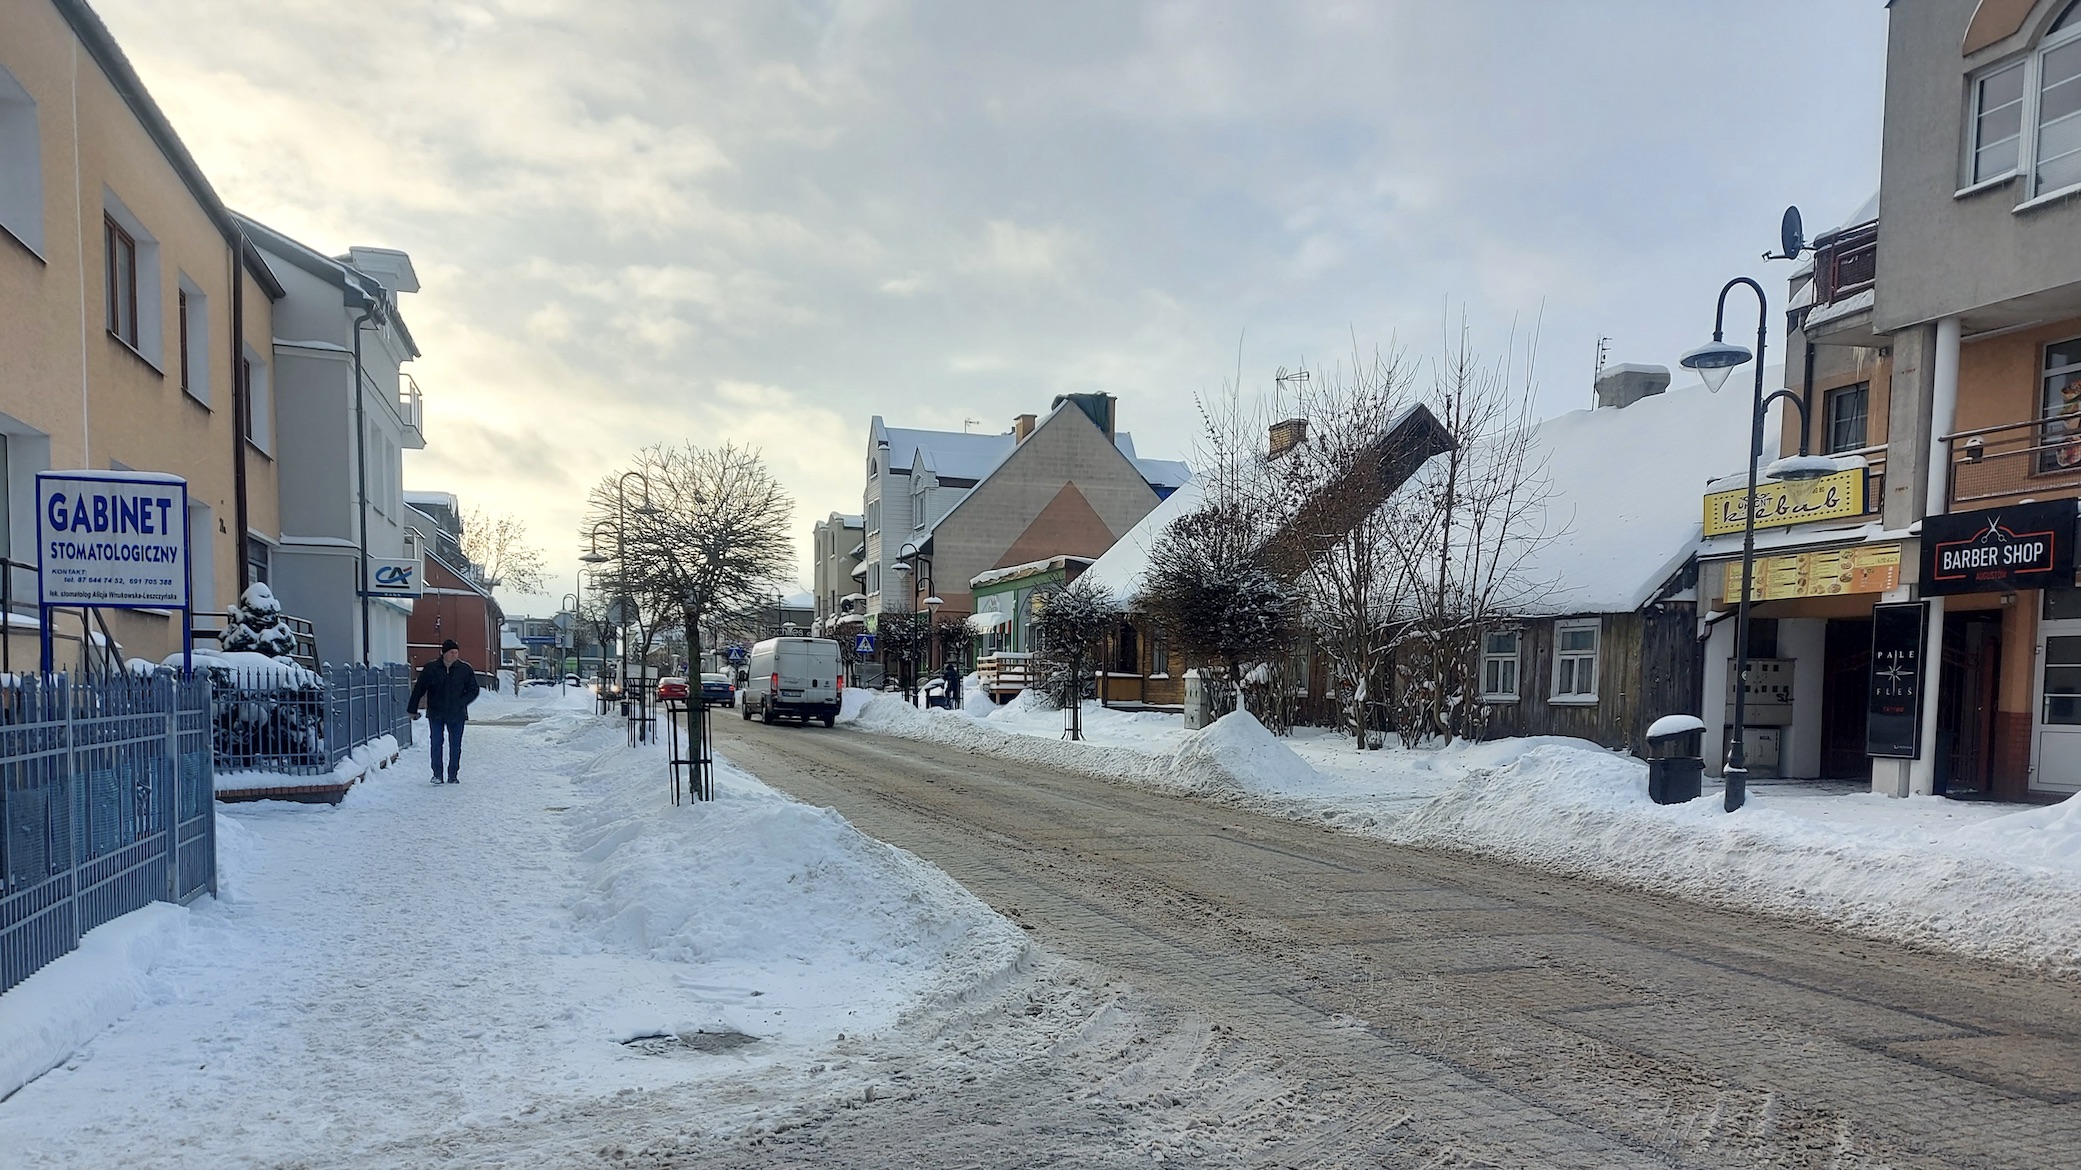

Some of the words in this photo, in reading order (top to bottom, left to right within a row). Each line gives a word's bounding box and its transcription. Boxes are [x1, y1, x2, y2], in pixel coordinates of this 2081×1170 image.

[48, 492, 172, 536] GABINET
[1723, 486, 1841, 523] kebab
[51, 542, 178, 564] STOMATOLOGICZNY
[1943, 547, 1998, 570] BARBER
[2003, 542, 2044, 565] SHOP
[61, 591, 91, 599] stomatolog
[92, 591, 107, 600] Alicja
[1877, 650, 1915, 659] PALE
